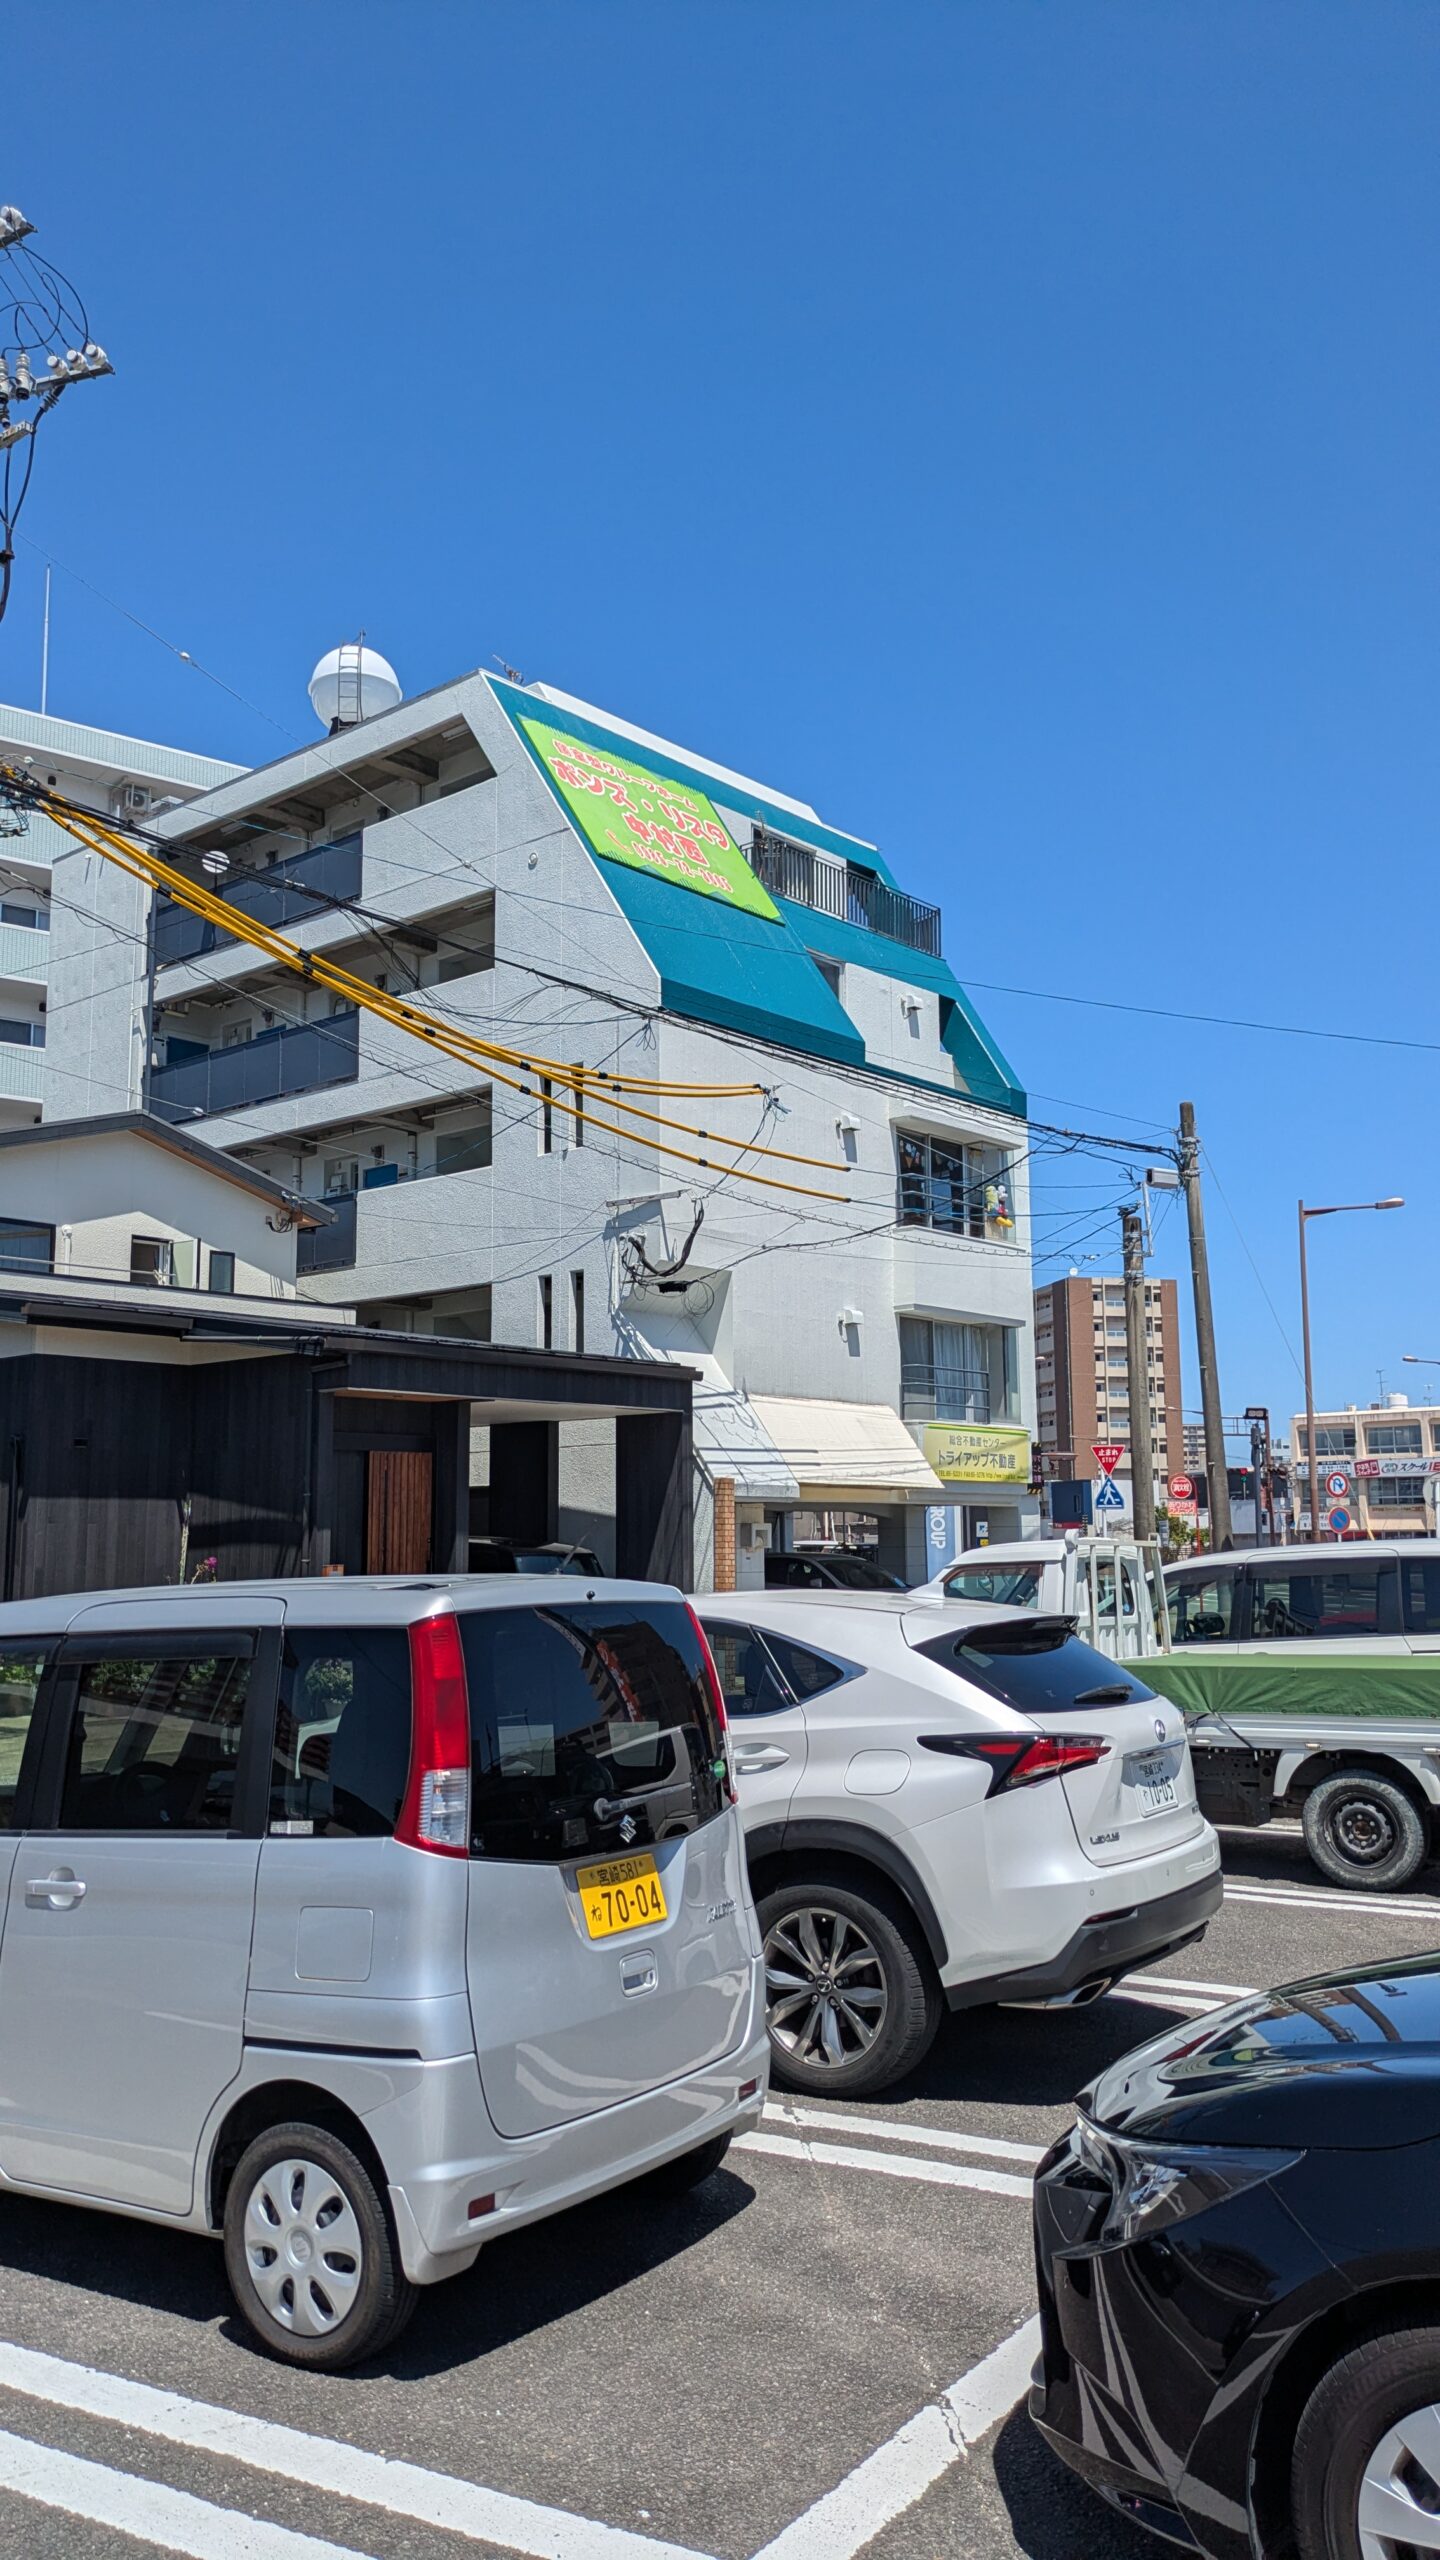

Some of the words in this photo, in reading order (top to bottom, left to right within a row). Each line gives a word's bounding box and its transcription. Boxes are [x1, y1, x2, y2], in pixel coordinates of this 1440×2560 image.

[622, 812, 710, 867] 中村西
[949, 1435, 1007, 1448] 総合不動産センター
[938, 1449, 1016, 1469] トライアップ不動産
[1399, 1462, 1427, 1471] スクール
[597, 1865, 620, 1887] 宮崎
[620, 1860, 639, 1880] 581
[591, 1904, 602, 1921] ね
[601, 1880, 661, 1927] 70-04
